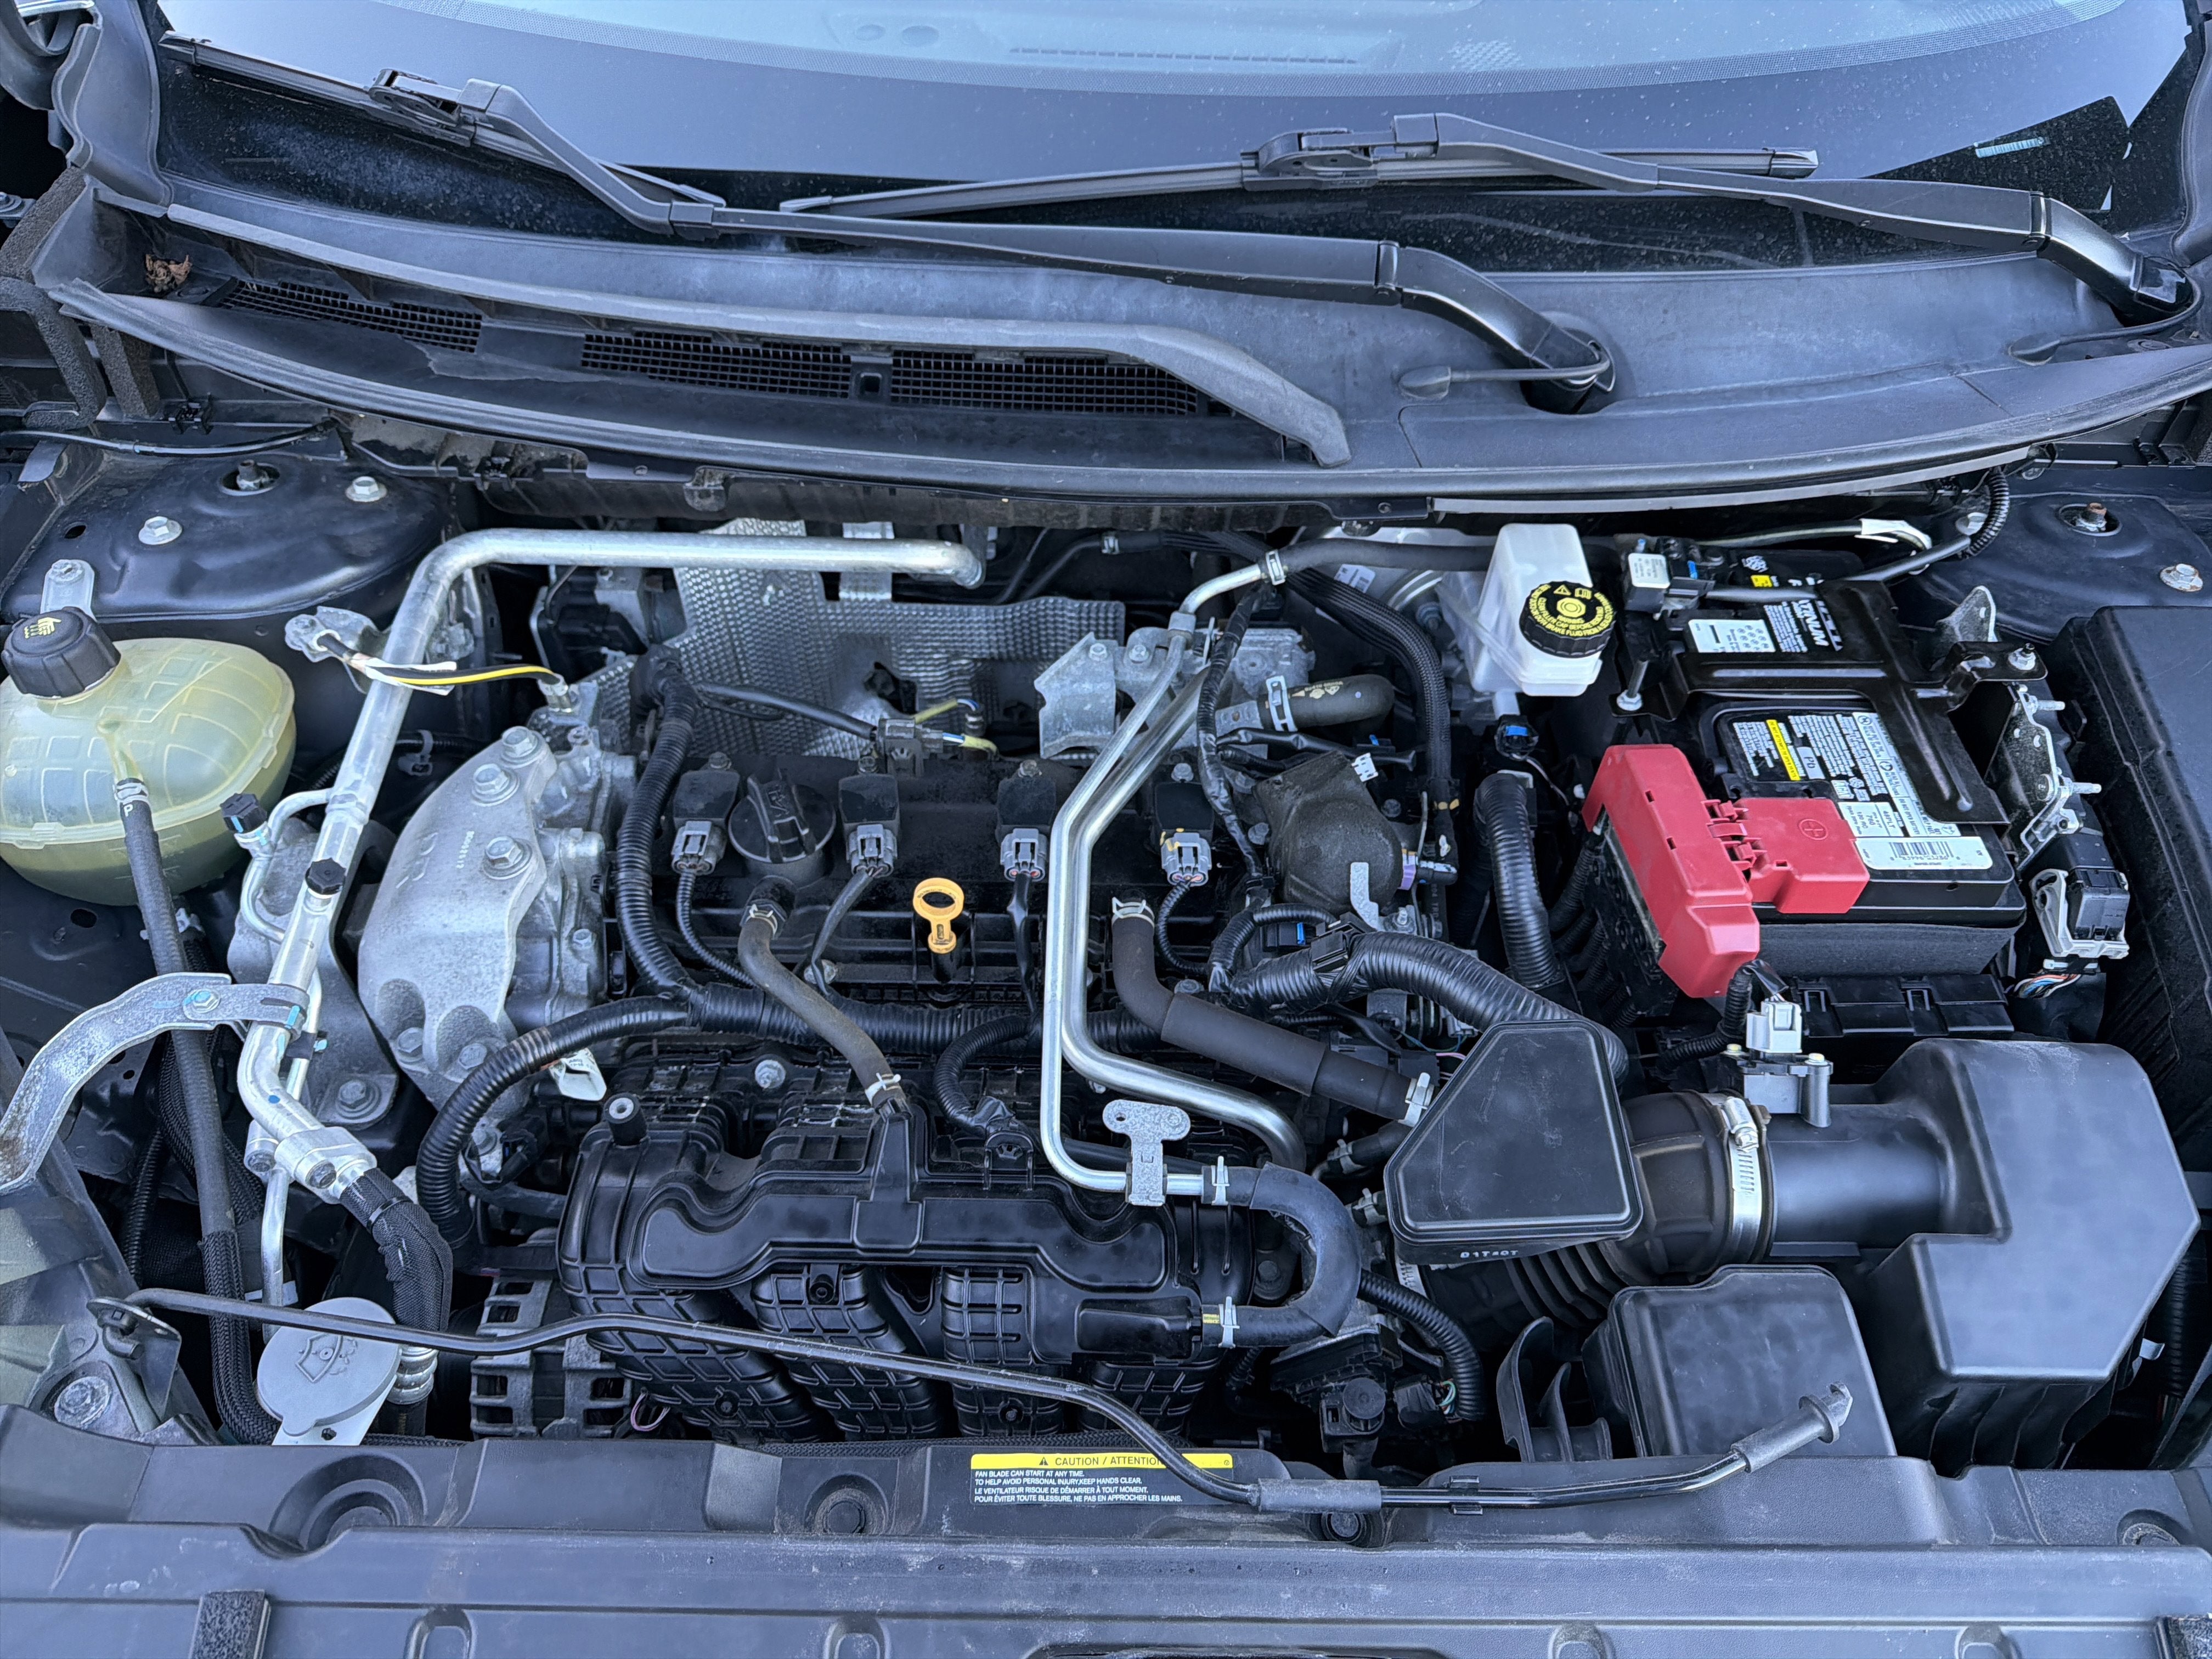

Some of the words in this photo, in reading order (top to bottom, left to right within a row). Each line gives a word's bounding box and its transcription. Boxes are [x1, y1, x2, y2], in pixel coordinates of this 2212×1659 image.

[1542, 611, 1558, 624] FILLER
[1555, 620, 1569, 629] CAP
[1545, 622, 1566, 635] BRAKE
[123, 804, 133, 817] P
[1055, 1457, 1099, 1466] CAUTION
